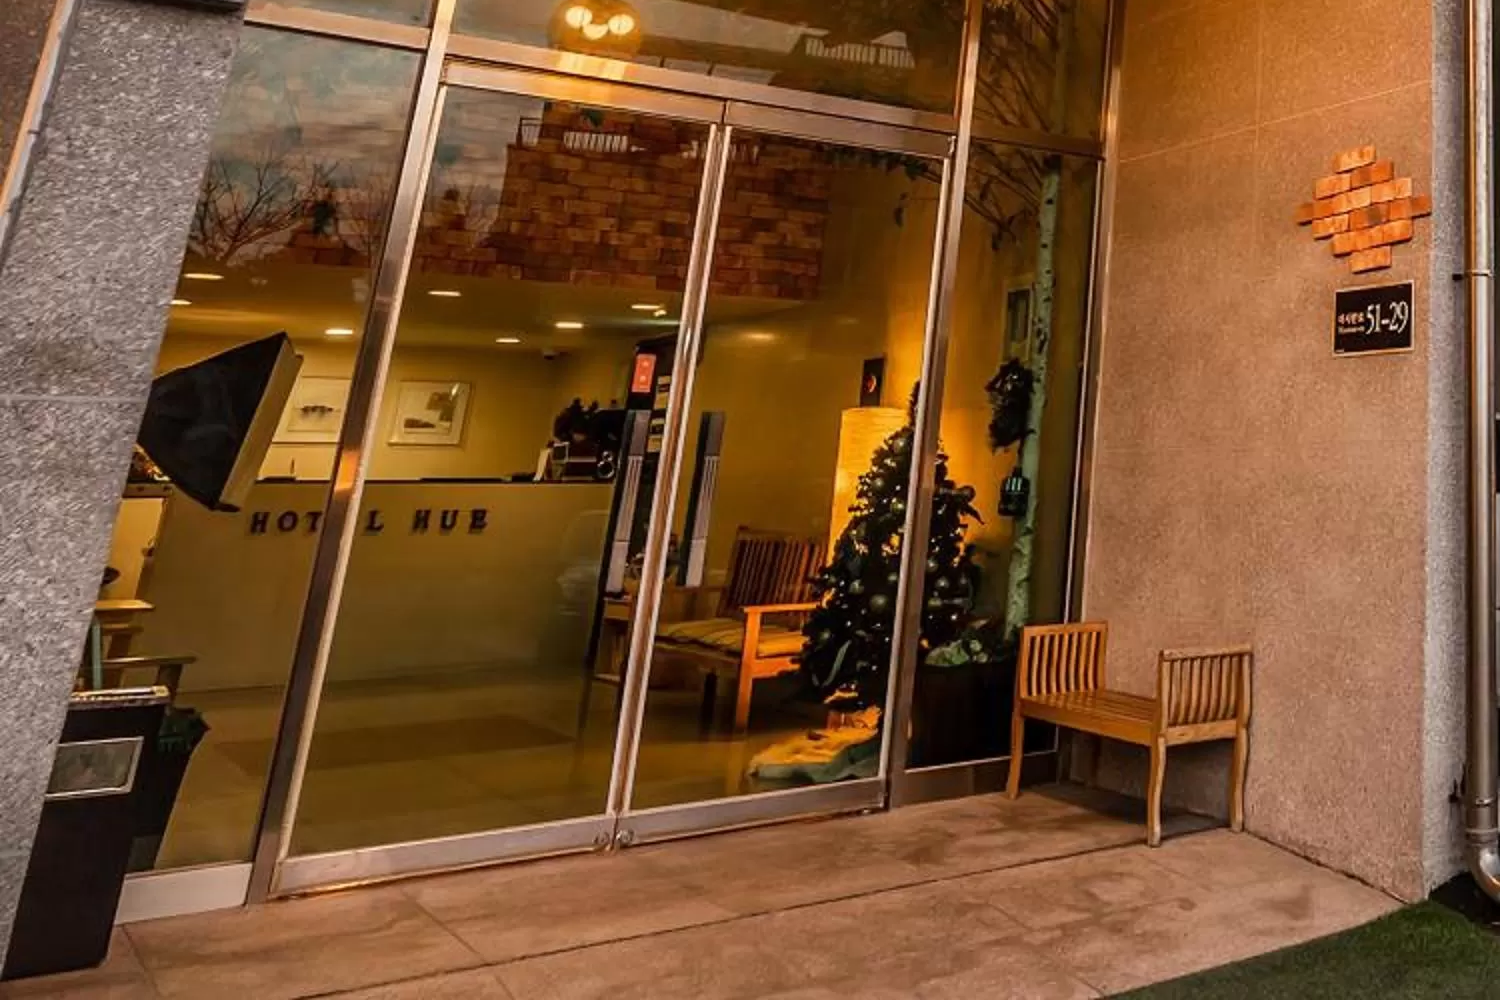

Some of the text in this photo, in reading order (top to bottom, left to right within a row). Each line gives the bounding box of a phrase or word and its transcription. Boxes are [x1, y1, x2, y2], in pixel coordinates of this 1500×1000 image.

[1365, 300, 1409, 335] 51-29
[250, 507, 488, 534] HOTL HUE
